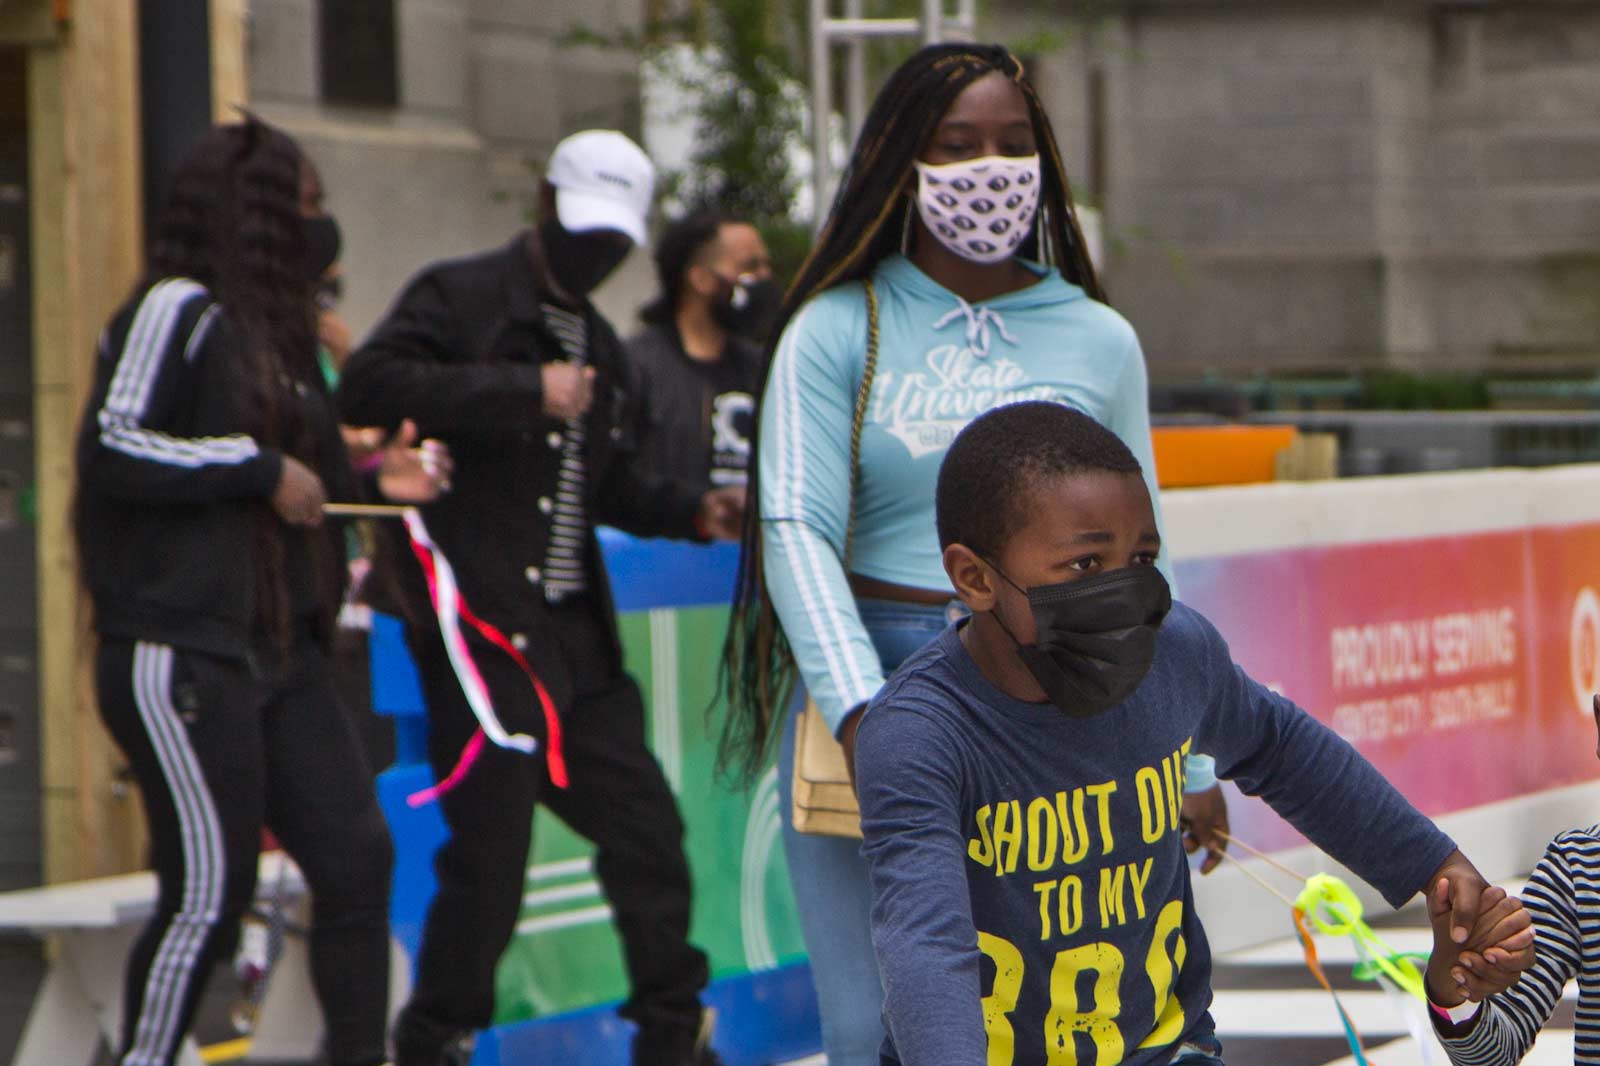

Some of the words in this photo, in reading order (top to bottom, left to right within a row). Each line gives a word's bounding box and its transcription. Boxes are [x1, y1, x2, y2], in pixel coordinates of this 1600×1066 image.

[926, 344, 1023, 390] Skate
[1331, 619, 1428, 688] PROUDLY
[1432, 606, 1516, 676] SERVING
[968, 780, 1117, 876] SHOUT
[1033, 875, 1083, 940] TO
[1100, 858, 1163, 929] MY
